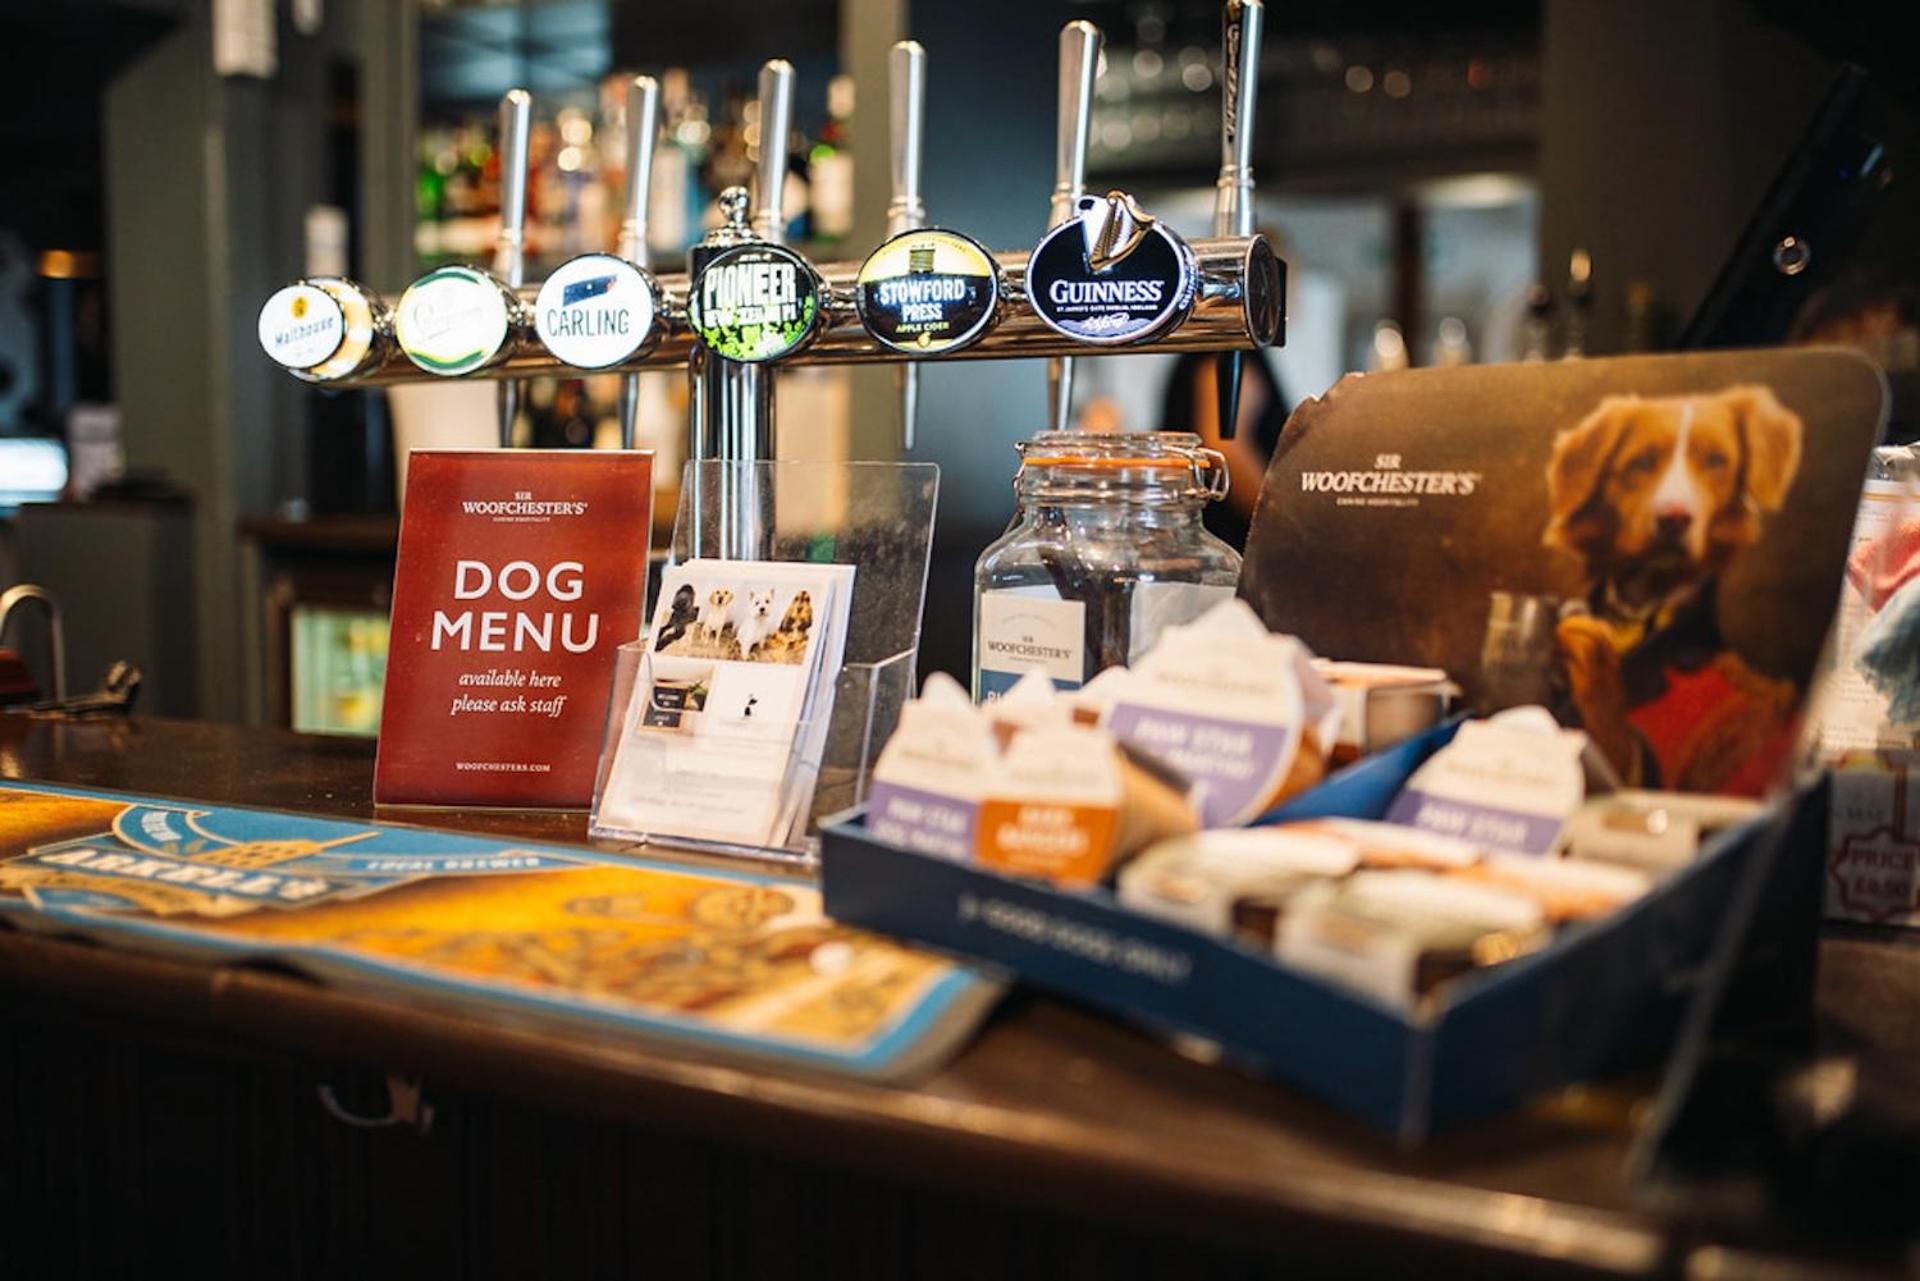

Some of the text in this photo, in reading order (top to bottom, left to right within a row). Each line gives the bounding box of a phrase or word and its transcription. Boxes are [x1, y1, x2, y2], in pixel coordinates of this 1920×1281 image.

[704, 262, 797, 310] PIONEER
[880, 279, 966, 306] STOWFORD
[1050, 279, 1164, 304] GUINNESS
[547, 308, 630, 337] CARLING
[902, 303, 944, 323] PRESS
[1373, 453, 1401, 470] SIR
[1301, 471, 1476, 496] WOOFCHESTER'S
[462, 501, 584, 515] WOOFCHESTER'S
[454, 560, 584, 601] DOG
[431, 610, 599, 653] MENU
[459, 668, 562, 688] available here
[450, 693, 568, 718] please ask staff
[456, 762, 551, 773] WOOFCHESTERS.COM
